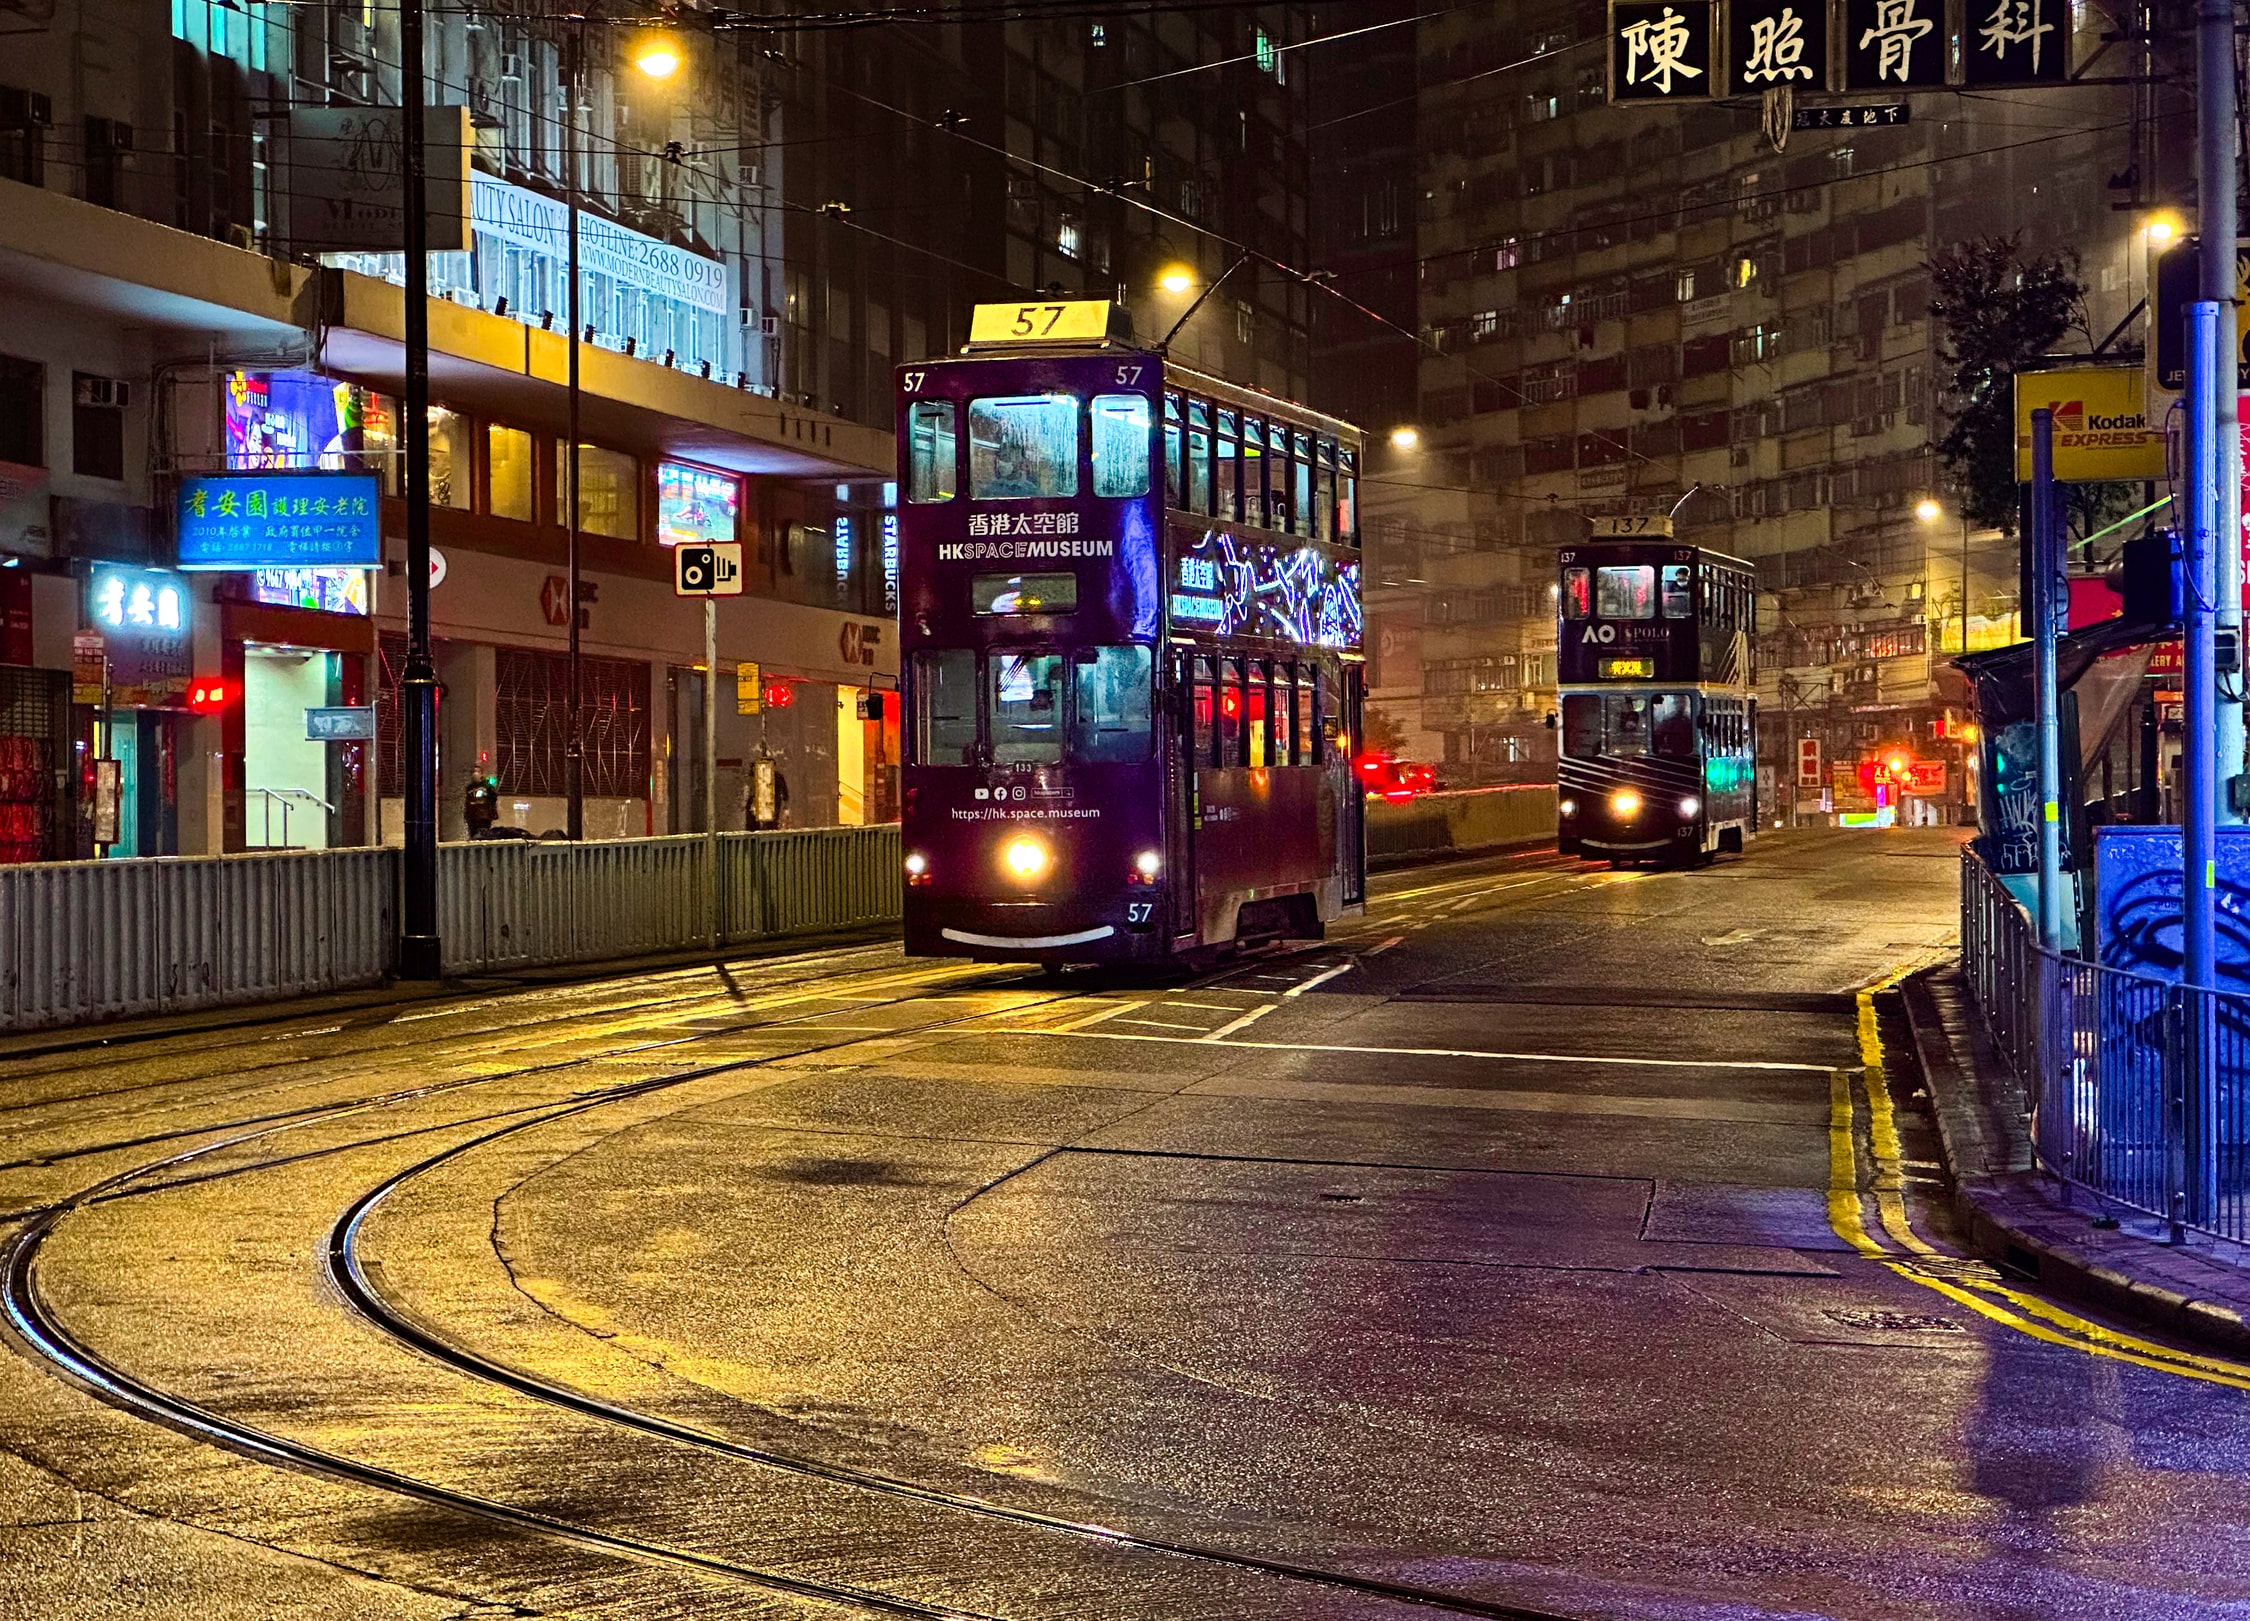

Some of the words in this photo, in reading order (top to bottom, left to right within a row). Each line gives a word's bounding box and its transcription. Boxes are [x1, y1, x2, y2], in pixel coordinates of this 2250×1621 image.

[1621, 0, 2054, 94] 陳照骨科
[508, 193, 555, 246] SALON
[685, 258, 723, 289] 0919
[1011, 306, 1065, 336] 57
[903, 372, 925, 392] 57
[1115, 366, 1142, 385] 57
[2088, 413, 2145, 430] Kodak
[2061, 431, 2148, 447] EXPRESS
[968, 512, 1079, 536] 香港太空館
[1612, 518, 1648, 534] 137
[884, 515, 898, 611] STARBUCKS
[1561, 553, 1576, 563] 137
[1674, 550, 1692, 561] 137
[1633, 627, 1670, 638] POLO
[1015, 763, 1032, 773] 133
[951, 807, 1100, 821] https://hk.space.museum
[1677, 827, 1693, 837] 137
[1127, 903, 1152, 922] 57
